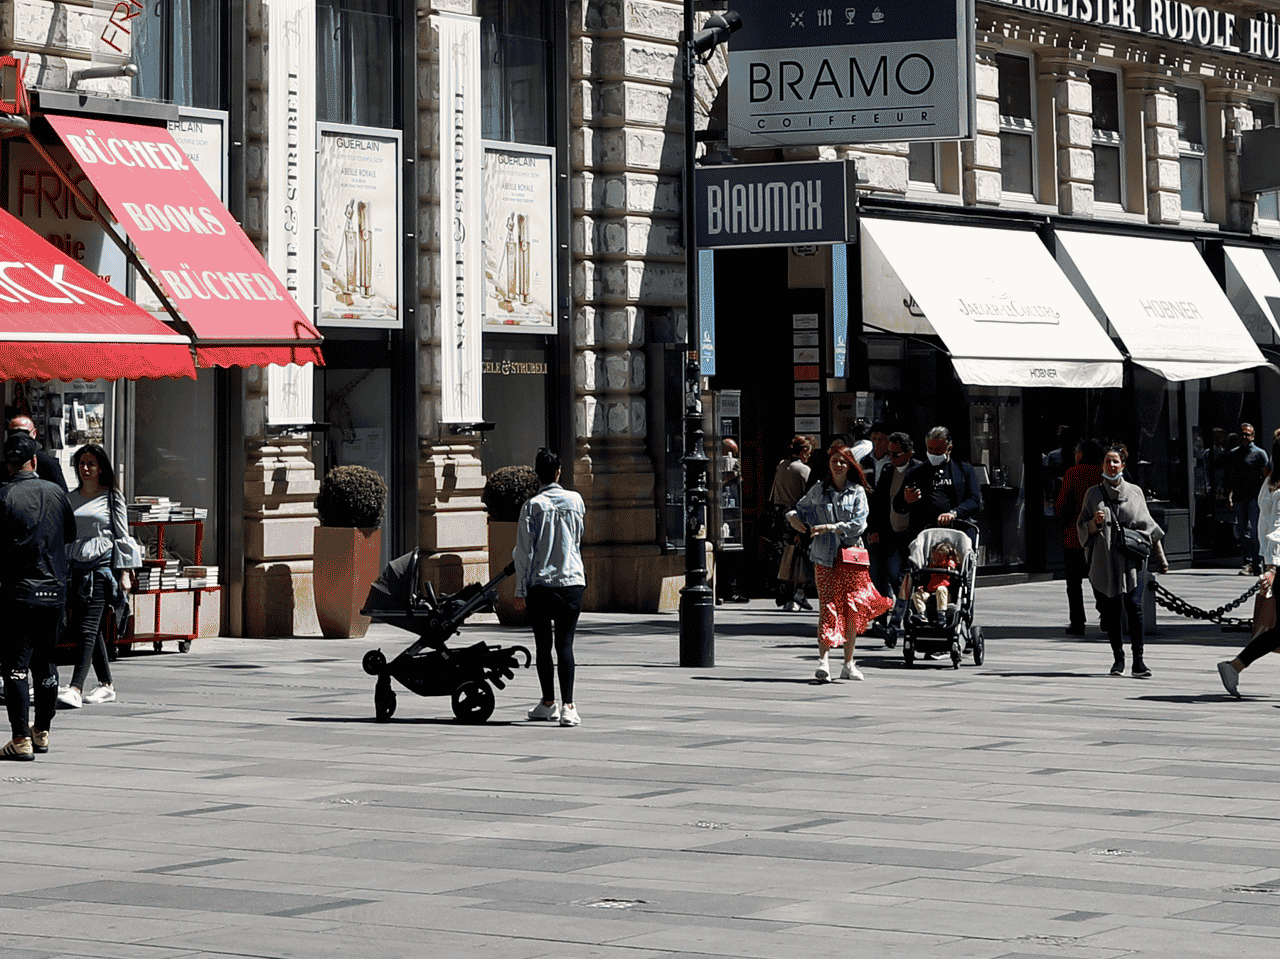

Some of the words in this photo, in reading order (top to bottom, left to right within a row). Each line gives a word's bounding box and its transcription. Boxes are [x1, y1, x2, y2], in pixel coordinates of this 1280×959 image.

[749, 53, 934, 103] BRAMO
[168, 121, 203, 133] ERLAIN
[757, 111, 928, 128] COIFFEUR
[65, 130, 189, 171] BÜCHER
[337, 138, 380, 151] GUERLAIN
[122, 202, 226, 236] BOOKS
[161, 263, 283, 302] BÜCHER
